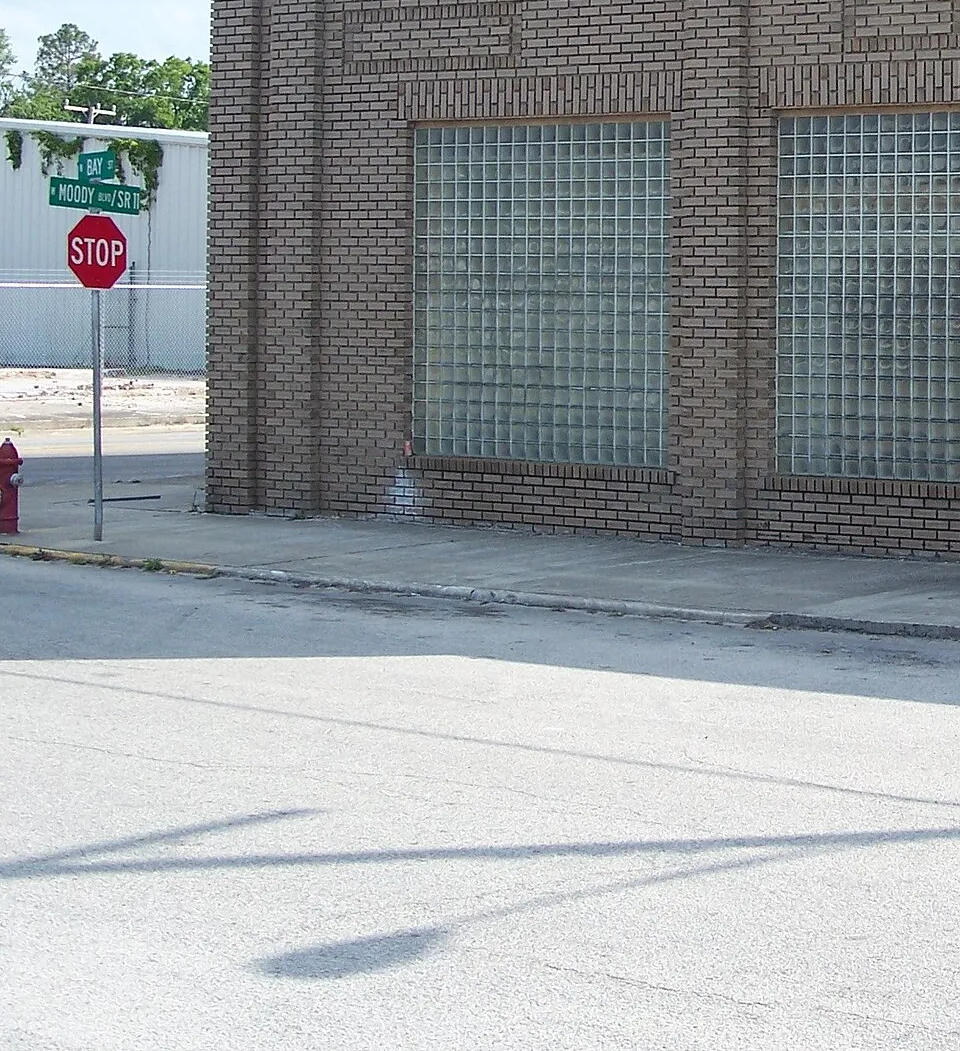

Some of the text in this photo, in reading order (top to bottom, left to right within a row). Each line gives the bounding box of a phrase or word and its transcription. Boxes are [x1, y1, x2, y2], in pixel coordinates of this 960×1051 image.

[86, 157, 103, 176] BAY
[107, 159, 114, 170] ST
[58, 184, 95, 204] MOODY
[71, 237, 124, 267] STOP
